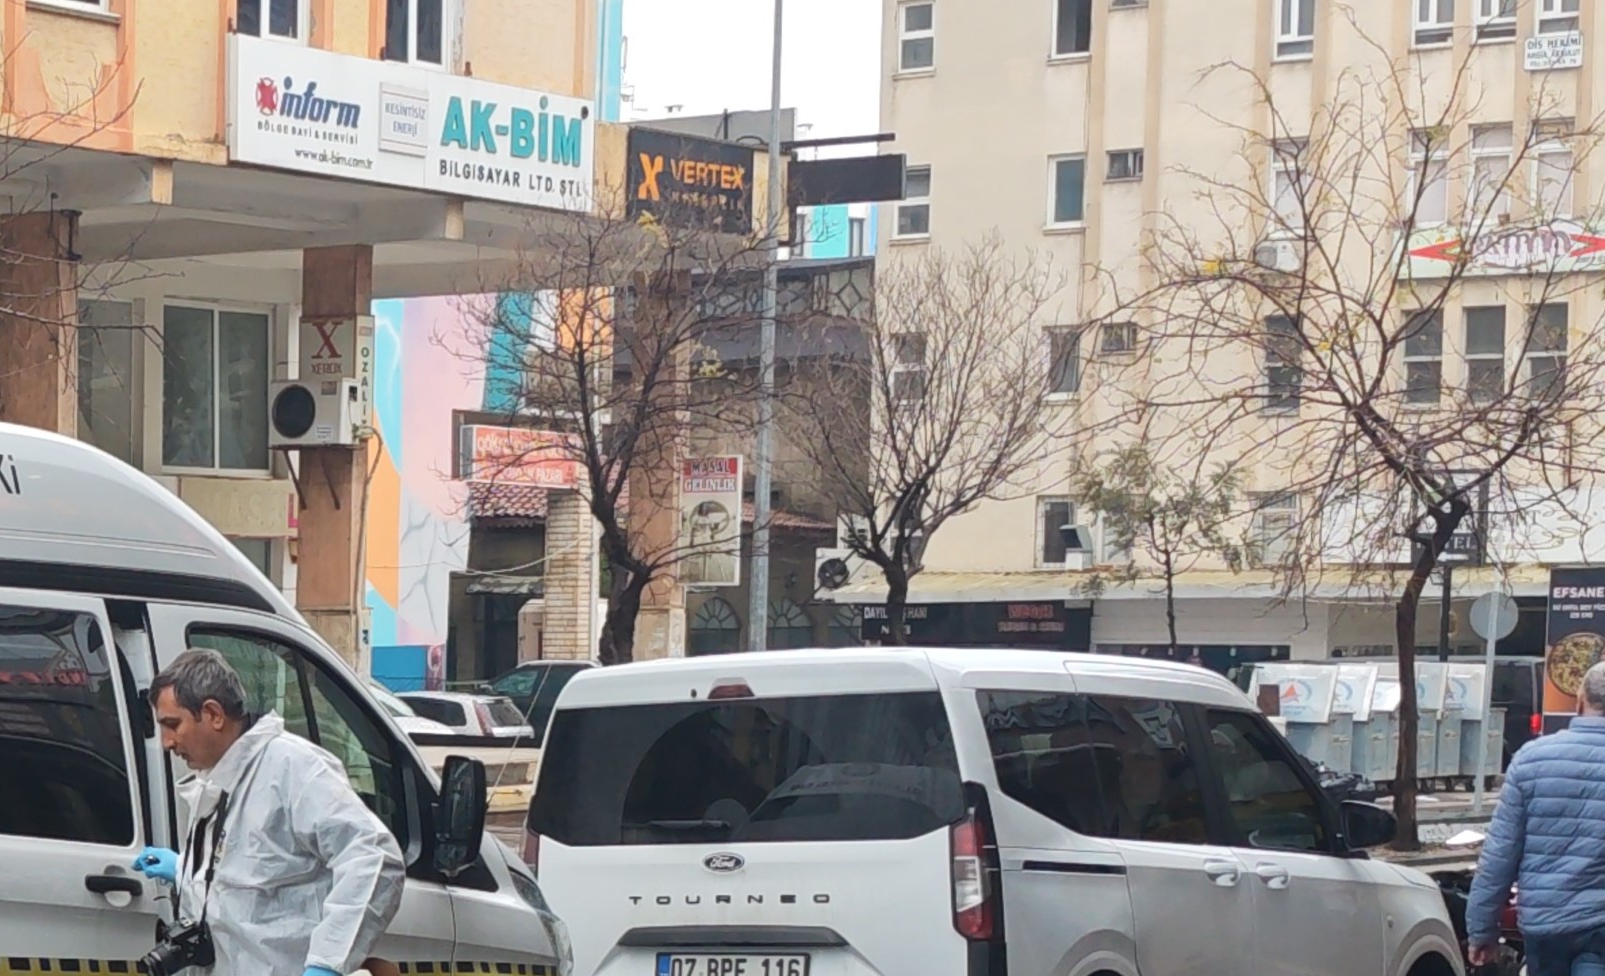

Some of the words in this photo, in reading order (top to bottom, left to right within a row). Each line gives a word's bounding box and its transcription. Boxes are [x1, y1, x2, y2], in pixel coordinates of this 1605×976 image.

[280, 76, 362, 129] inform
[257, 120, 289, 135] BÖLGE
[322, 130, 359, 145] SERVİSİ
[439, 95, 583, 167] AK-BİM
[439, 159, 520, 188] BİLGİSAYAR
[670, 158, 746, 190] VERTEX
[311, 363, 343, 375] XEROX
[1552, 587, 1605, 599] EFSANE
[708, 855, 738, 870] Ford
[628, 893, 830, 906] TOURNEO
